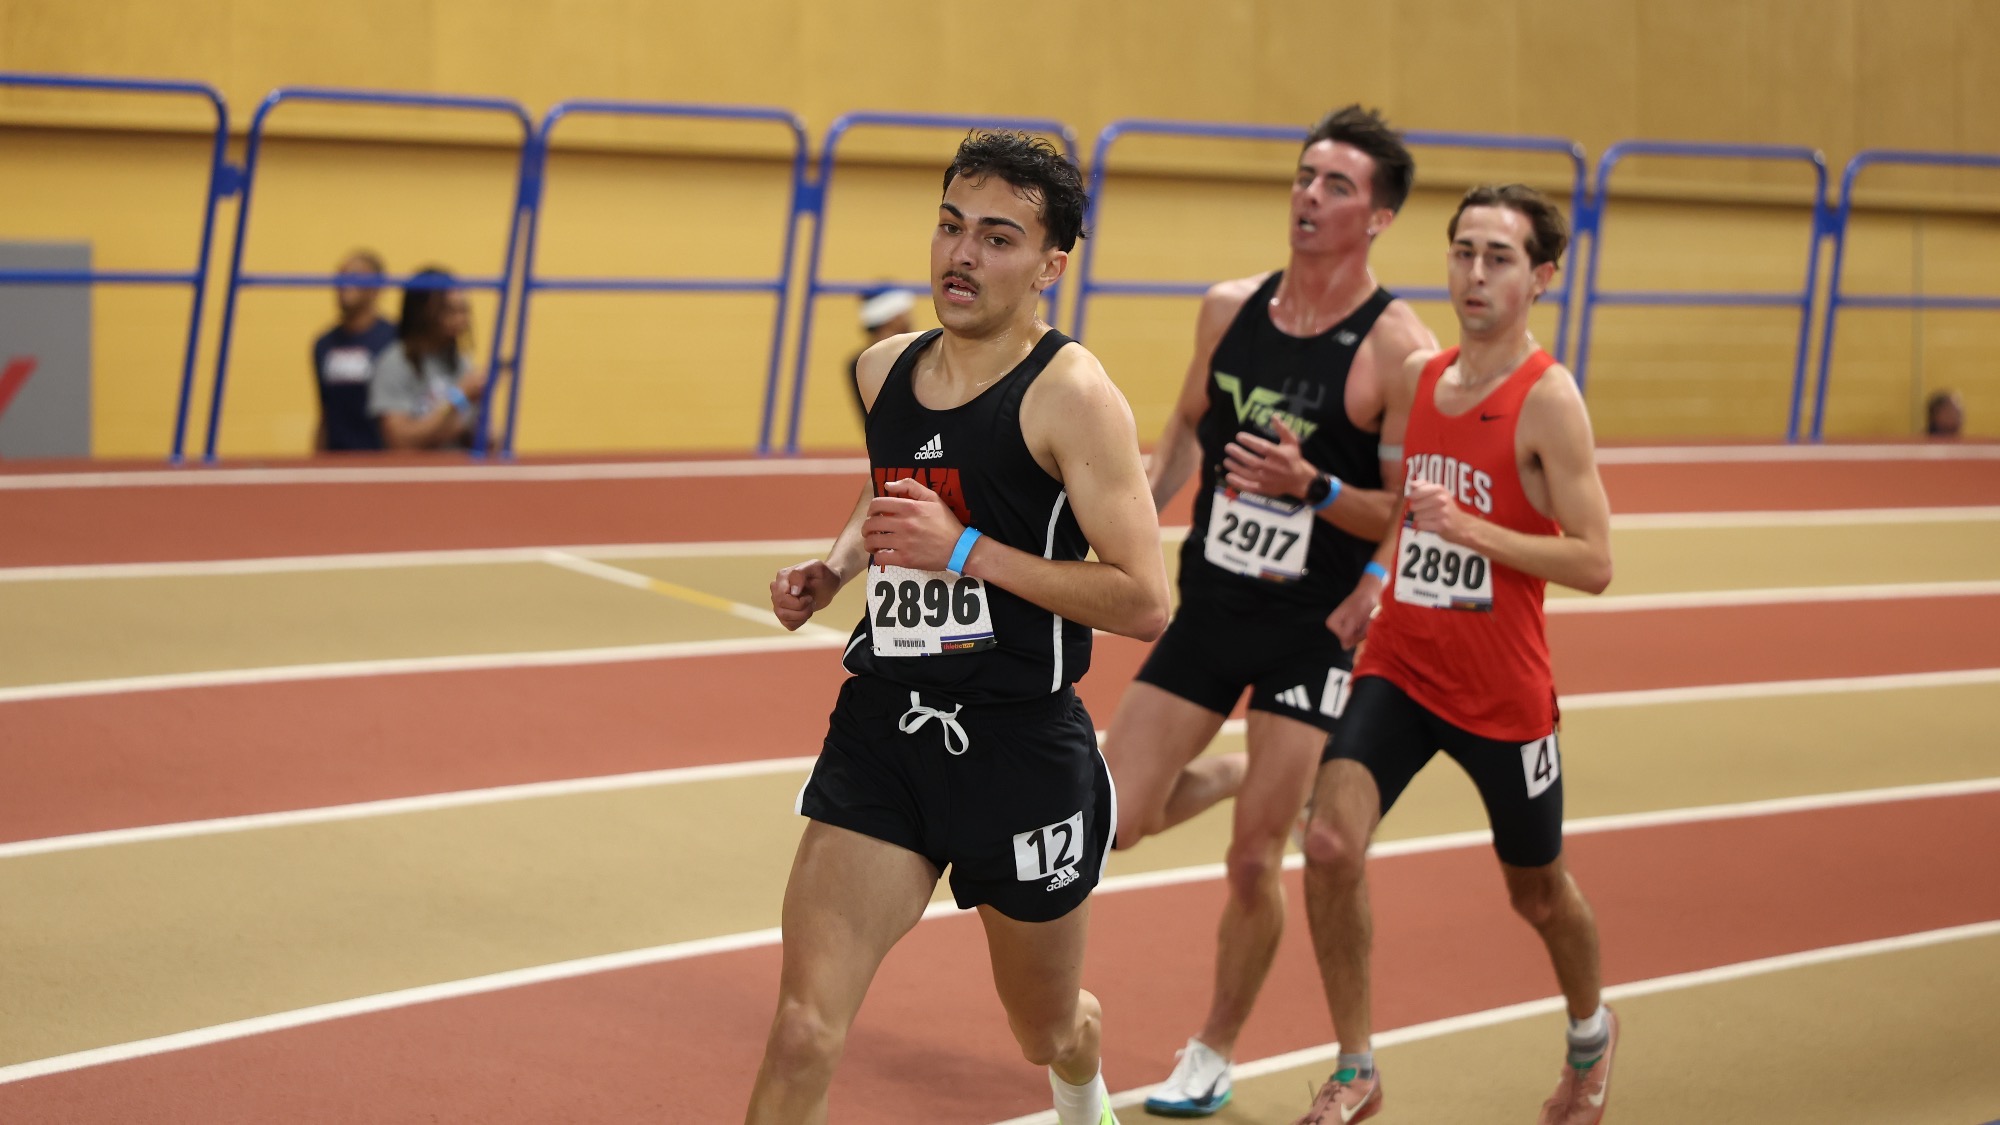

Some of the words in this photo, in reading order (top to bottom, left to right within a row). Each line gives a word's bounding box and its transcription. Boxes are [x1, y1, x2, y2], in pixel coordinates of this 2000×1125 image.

[914, 449, 944, 460] adidas
[1217, 512, 1301, 561] 2917
[1401, 543, 1486, 591] 2890
[874, 576, 981, 629] 2896
[1533, 738, 1552, 782] 4
[1026, 822, 1075, 876] 12
[1046, 870, 1080, 892] adidas
